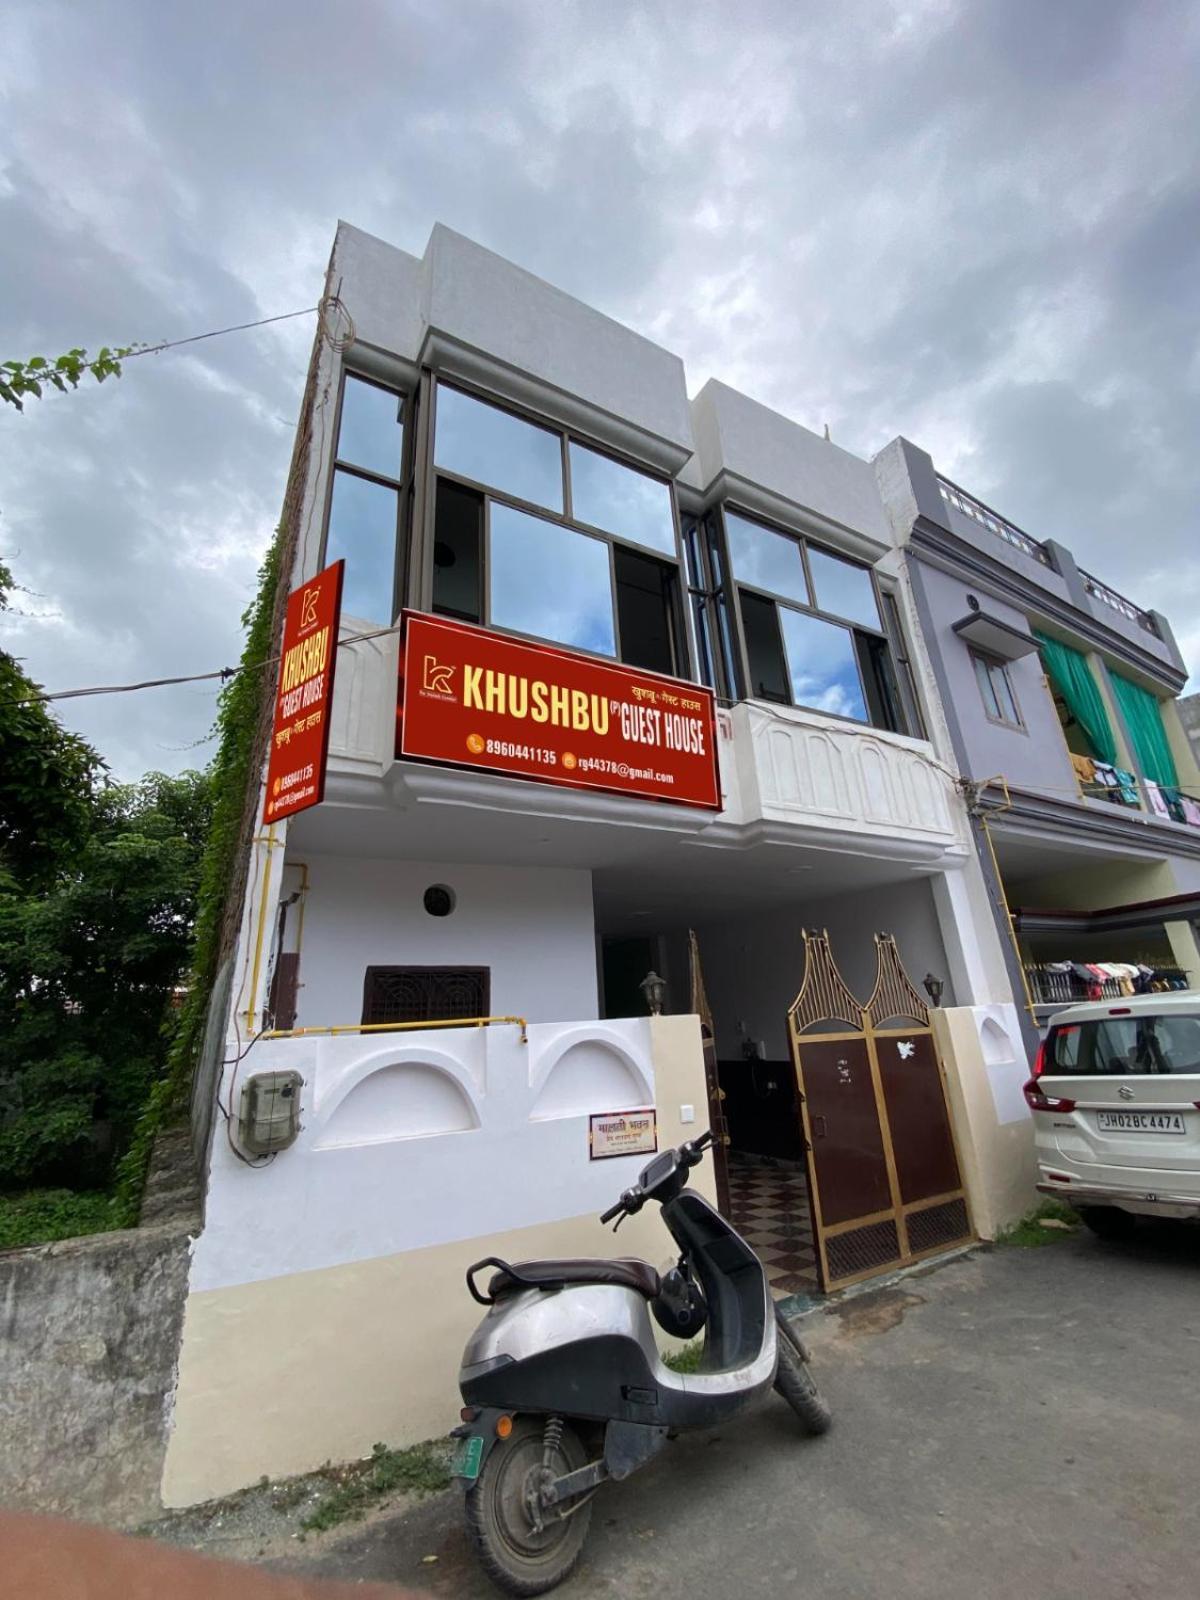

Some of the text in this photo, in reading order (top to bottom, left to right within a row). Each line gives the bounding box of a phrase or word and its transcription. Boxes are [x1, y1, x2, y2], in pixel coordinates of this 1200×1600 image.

[282, 626, 329, 695] KHUSHBU
[463, 664, 609, 736] KHUSHBU
[621, 701, 661, 747] GUEST
[664, 711, 706, 756] HOUSE
[486, 739, 557, 765] 8960441135
[578, 757, 674, 784] rg44378@gmail.com
[1105, 1114, 1181, 1129] JH02BC4474
